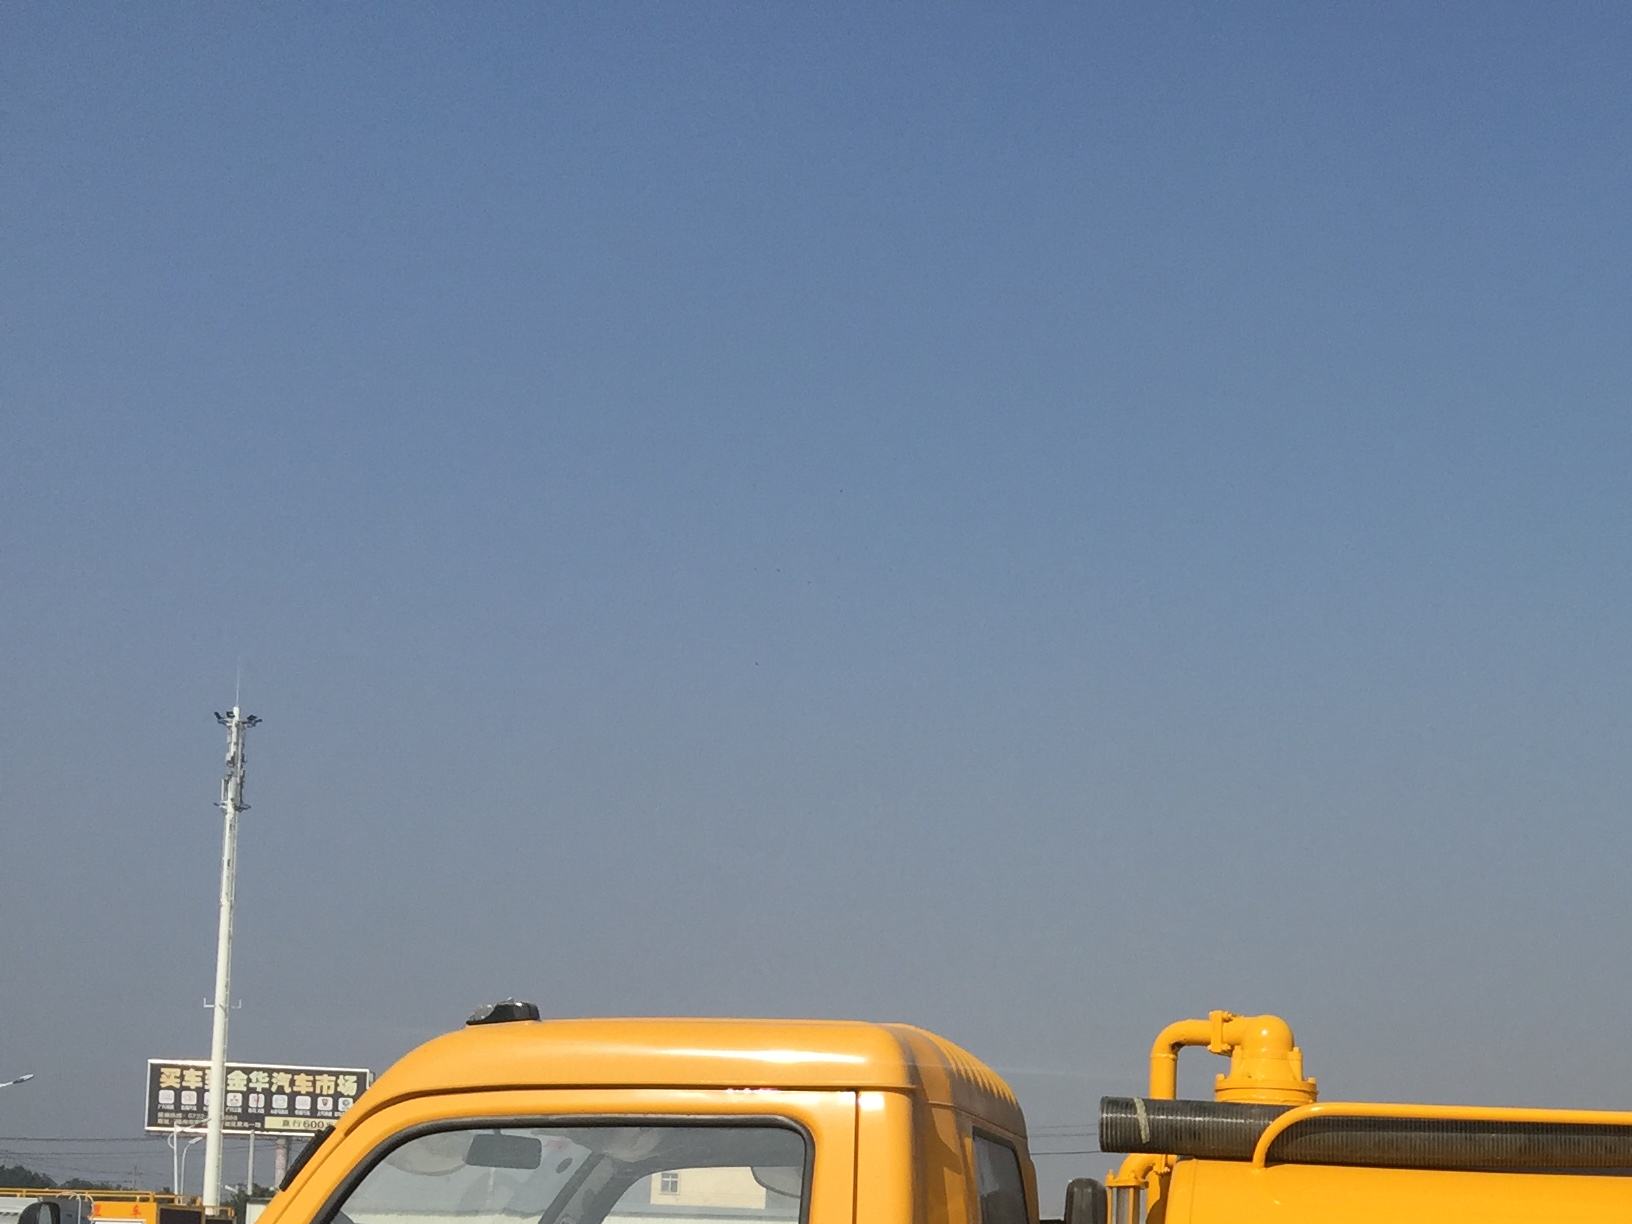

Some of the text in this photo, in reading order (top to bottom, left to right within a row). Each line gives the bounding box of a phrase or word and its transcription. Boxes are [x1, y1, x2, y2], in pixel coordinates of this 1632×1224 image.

[160, 1067, 357, 1096] 买车金华汽车市场
